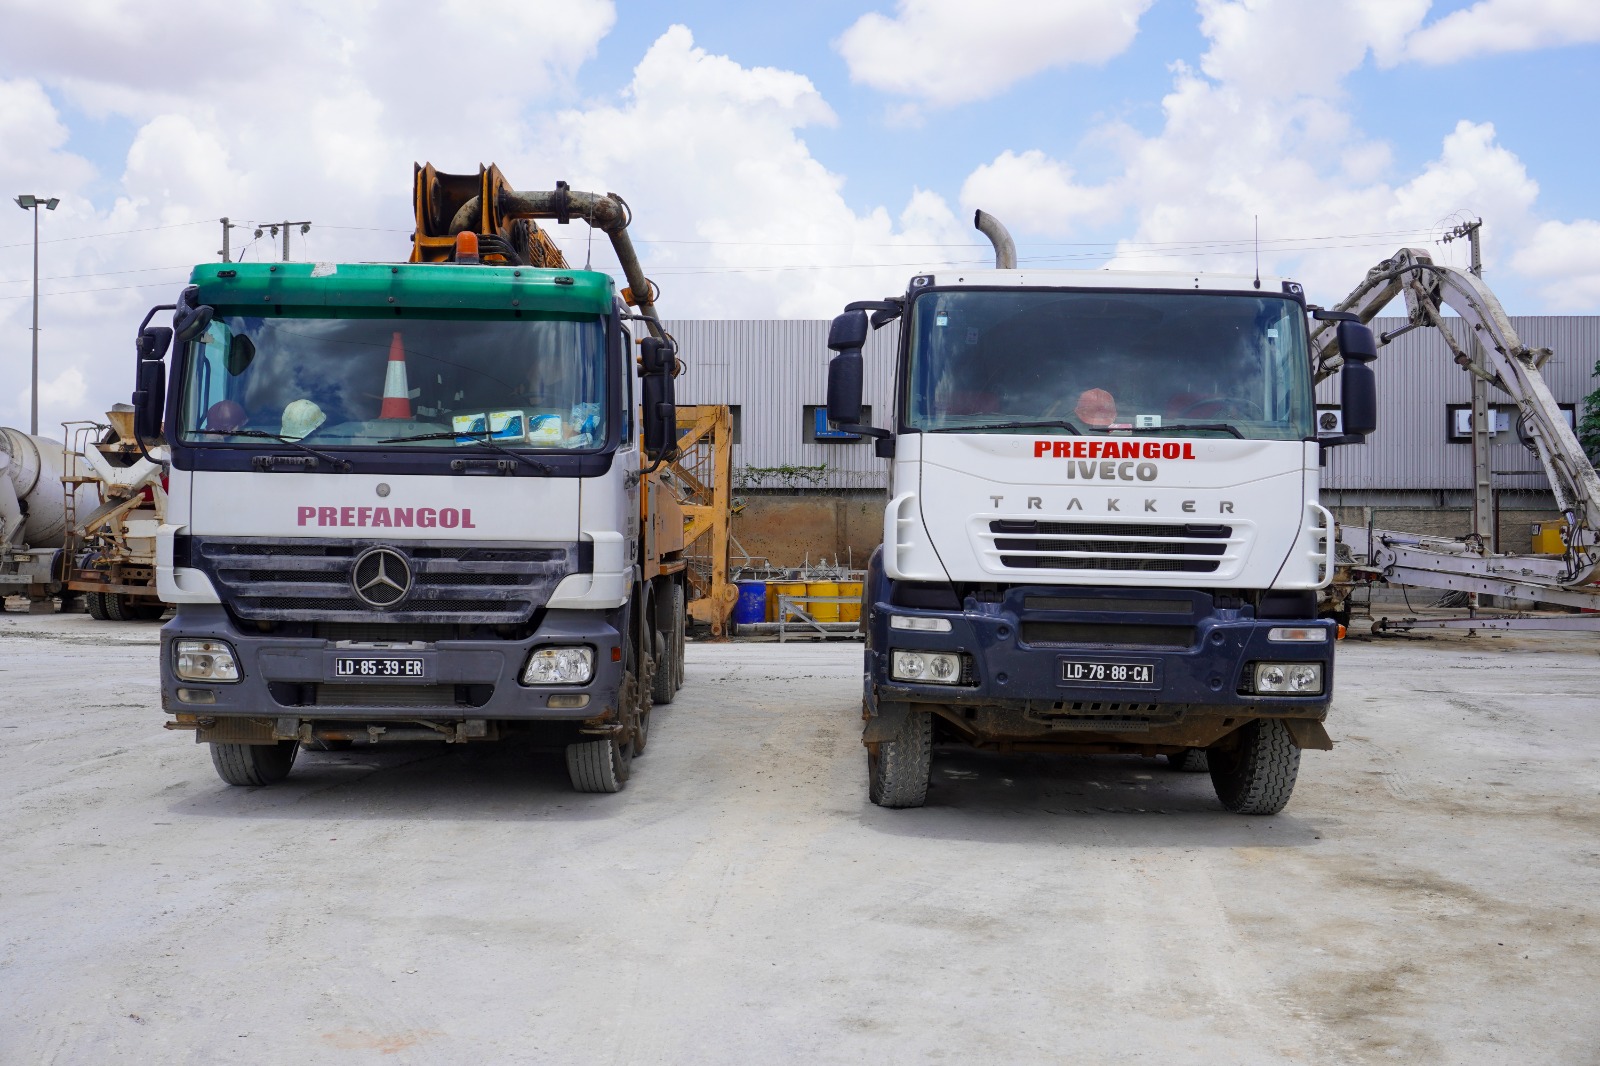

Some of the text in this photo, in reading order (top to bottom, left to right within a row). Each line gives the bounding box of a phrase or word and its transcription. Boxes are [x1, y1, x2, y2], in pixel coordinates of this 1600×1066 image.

[1033, 440, 1196, 460] PREFANGOL
[1066, 460, 1159, 482] IVECO
[989, 495, 1235, 514] TRAKKER
[297, 506, 476, 529] PREFANGOL
